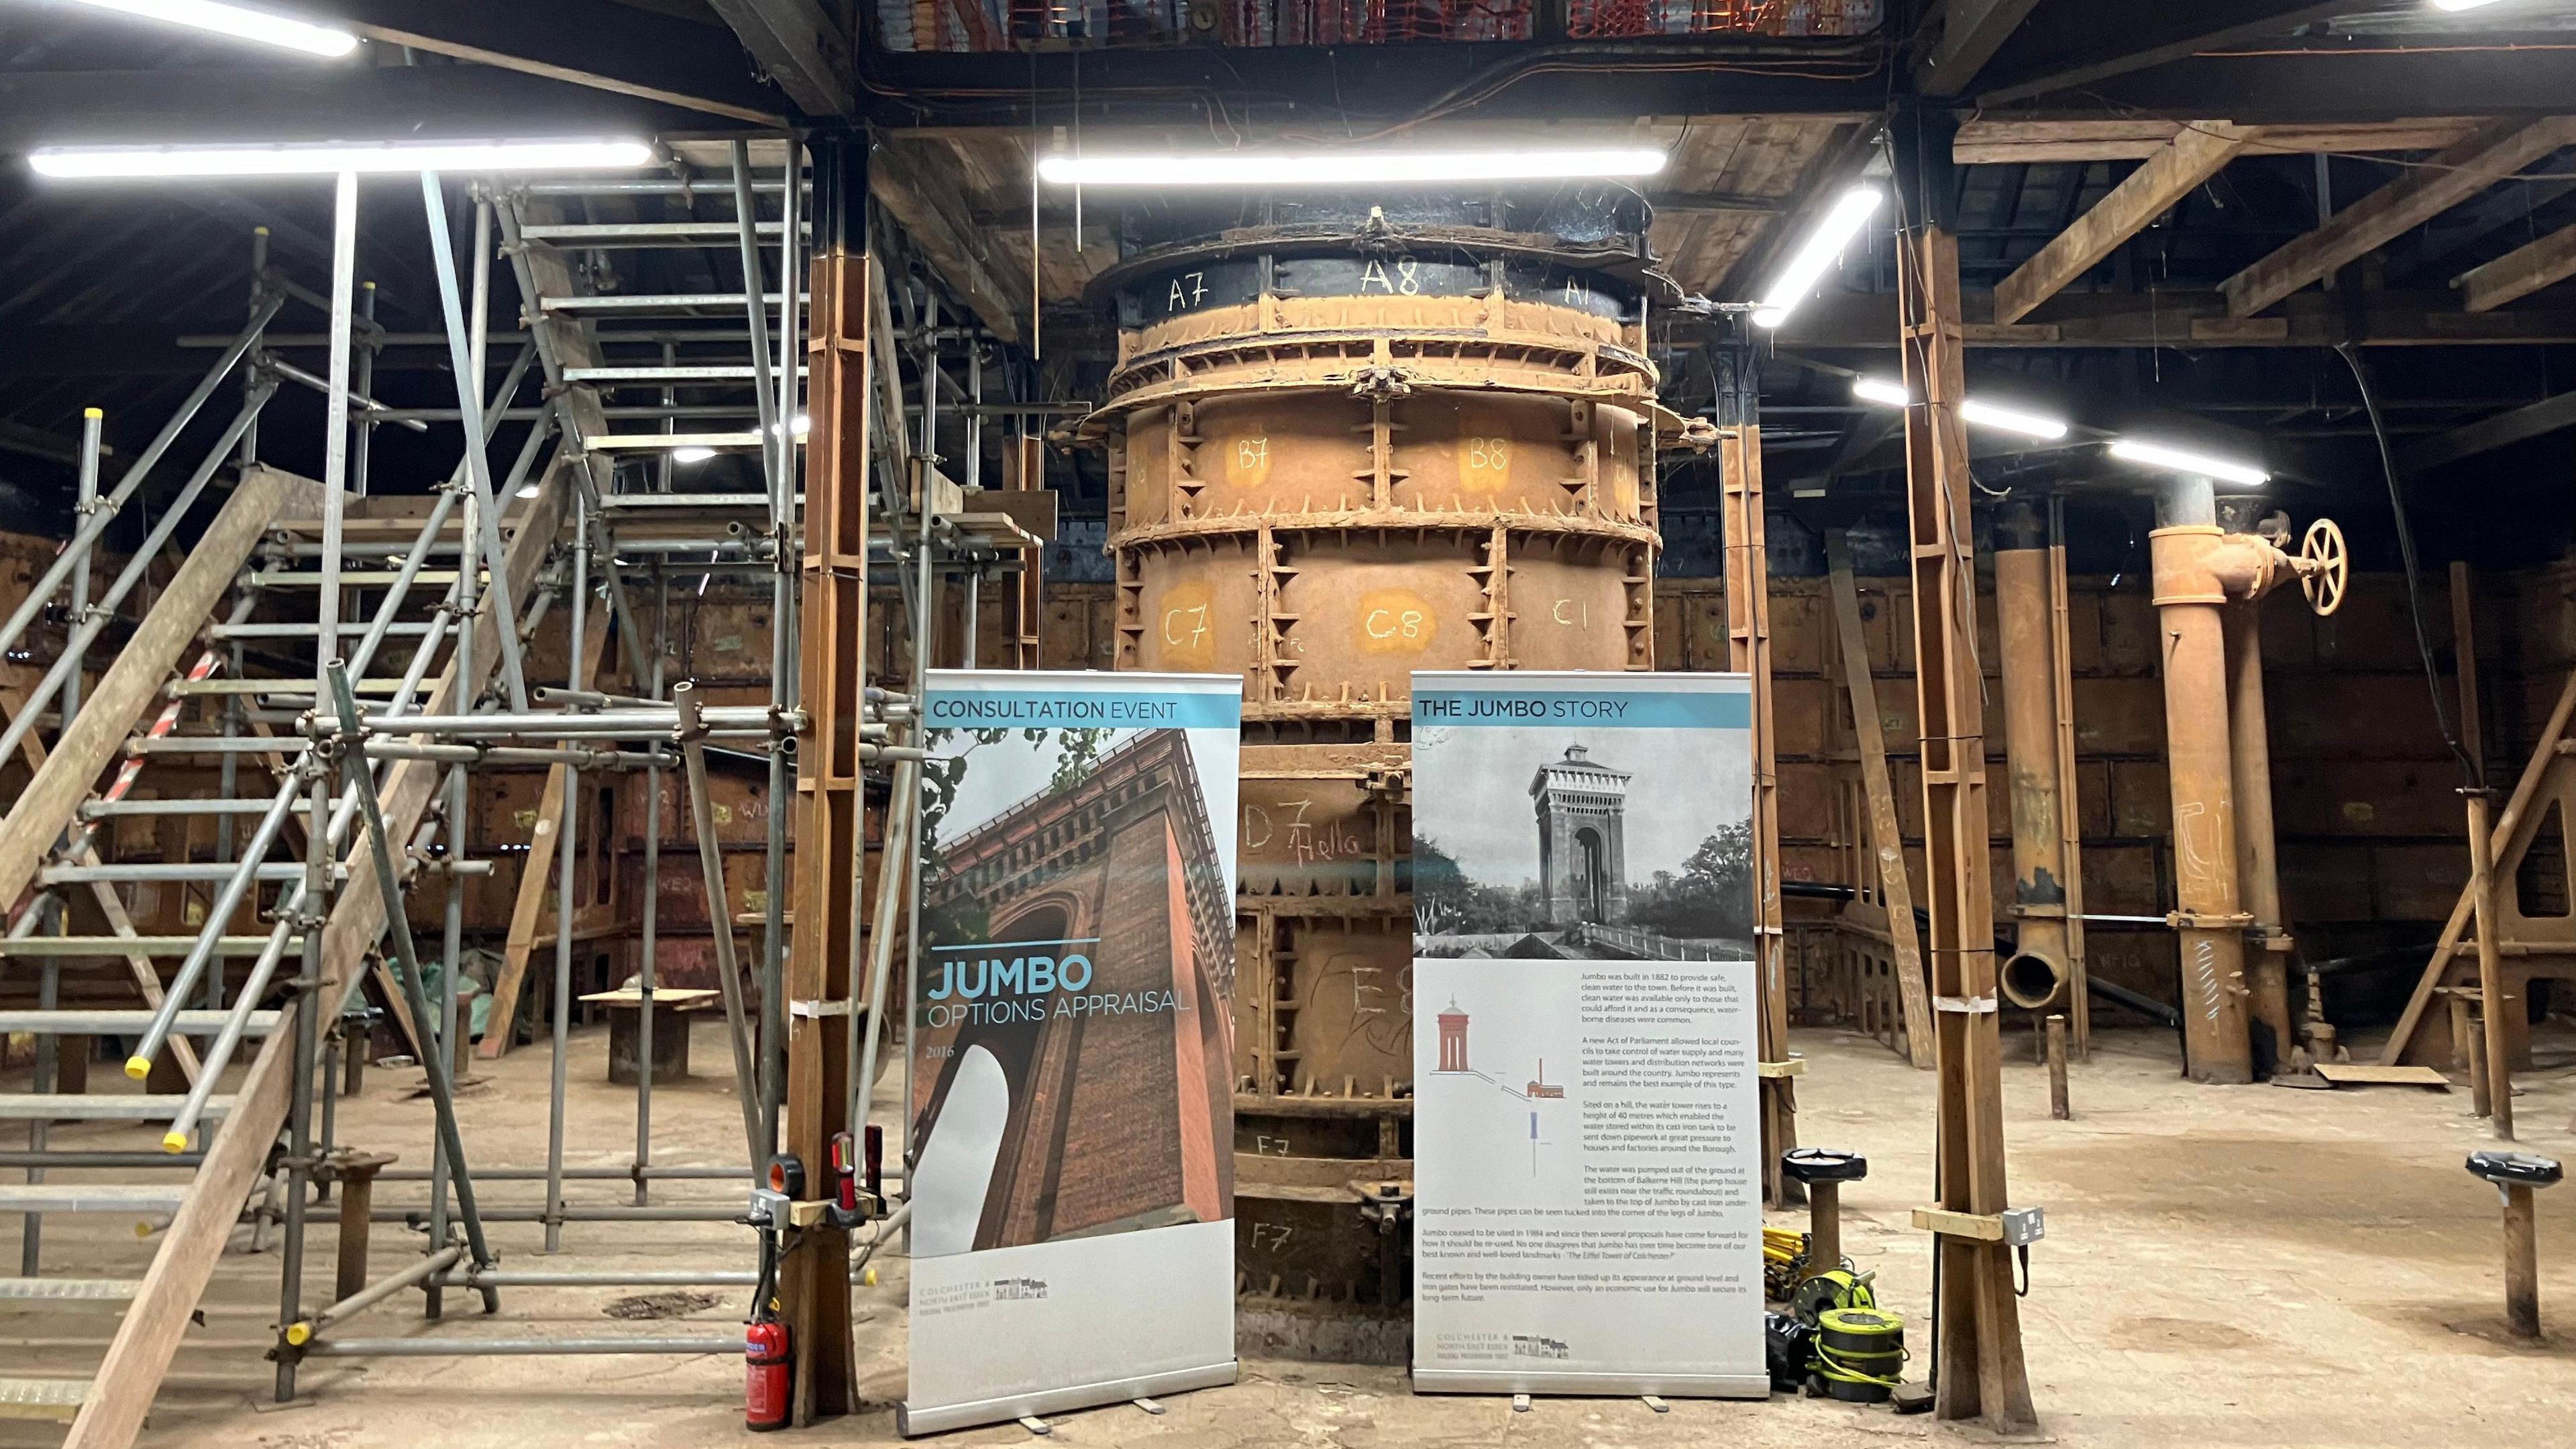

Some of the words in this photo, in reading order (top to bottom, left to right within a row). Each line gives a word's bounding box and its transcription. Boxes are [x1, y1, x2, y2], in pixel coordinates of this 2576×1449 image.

[1361, 256, 1419, 296] A8
[1169, 272, 1208, 311] A7
[1238, 437, 1269, 469] B7
[1470, 437, 1507, 470] B8
[1552, 598, 1587, 631] C1
[1165, 603, 1208, 650] C7
[1366, 610, 1423, 639] C8
[933, 700, 1104, 718] CONSULTATION
[1111, 702, 1178, 719] EVENT
[1419, 700, 1462, 717] THE
[1468, 700, 1546, 718] JUMBO
[1553, 701, 1629, 718] STORY
[928, 954, 1093, 1001] JUMBO
[1581, 971, 1606, 979] Jumbo
[1623, 972, 1640, 980] built
[1642, 972, 1649, 980] in
[1652, 972, 1669, 981] 1882
[1670, 972, 1678, 981] to
[1680, 973, 1709, 982] provide
[1581, 982, 1601, 990] clean
[1602, 982, 1623, 991] water
[1625, 982, 1633, 991] to
[1633, 983, 1646, 991] the
[1670, 983, 1695, 991] Before
[1696, 983, 1701, 991] it
[1581, 993, 1601, 1001] clean
[1602, 993, 1623, 1002] water
[1641, 994, 1673, 1002] available
[1674, 994, 1690, 1004] only
[1693, 994, 1701, 1002] to
[1703, 994, 1723, 1003] those
[1724, 994, 1739, 1003] that
[928, 998, 1046, 1028] OPTIONS
[1053, 989, 1191, 1020] APPRAISAL
[1582, 1004, 1602, 1012] could
[1604, 1004, 1625, 1012] afford
[1627, 1004, 1632, 1012] it
[1633, 1004, 1648, 1012] and
[1582, 1014, 1603, 1022] borne
[1605, 1014, 1635, 1023] diseases
[1582, 1035, 1588, 1043] A
[1607, 1035, 1619, 1044] Act
[1621, 1035, 1628, 1044] of
[1629, 1036, 1669, 1044] Parliament
[1671, 1036, 1700, 1044] allowed
[1702, 1036, 1719, 1045] local
[926, 1046, 955, 1059] 2016
[1582, 1046, 1594, 1055] cils
[1595, 1046, 1603, 1055] to
[1605, 1046, 1620, 1055] take
[1622, 1047, 1648, 1055] control
[1650, 1047, 1658, 1055] of
[1659, 1047, 1680, 1056] water
[1682, 1048, 1707, 1057] supply
[1708, 1048, 1723, 1057] and
[1582, 1057, 1603, 1065] water
[1605, 1057, 1629, 1065] towers
[1631, 1057, 1646, 1065] and
[1647, 1057, 1690, 1066] distribution
[1692, 1058, 1726, 1067] networks
[1582, 1067, 1599, 1075] built
[1601, 1067, 1627, 1076] around
[1629, 1068, 1642, 1076] the
[1675, 1069, 1701, 1077] Jumbo
[1702, 1069, 1740, 1079] represents
[1582, 1078, 1597, 1086] and
[1599, 1078, 1627, 1087] remains
[1629, 1079, 1642, 1087] the
[1643, 1079, 1659, 1087] best
[1660, 1079, 1693, 1089] example
[1694, 1079, 1702, 1087] of
[1704, 1079, 1717, 1088] this
[1583, 1110, 1607, 1120] height
[1609, 1110, 1616, 1119] of
[1618, 1110, 1627, 1119] 40
[1629, 1111, 1654, 1119] metres
[1656, 1111, 1678, 1119] which
[1680, 1111, 1710, 1120] enabled
[1712, 1112, 1724, 1120] the
[1583, 1132, 1599, 1140] sent
[1601, 1132, 1622, 1141] down
[1623, 1133, 1658, 1142] pipework
[1660, 1133, 1667, 1141] at
[1669, 1133, 1688, 1143] great
[1723, 1134, 1731, 1142] to
[1257, 1136, 1289, 1157] F7
[1585, 1165, 1597, 1173] The
[1599, 1165, 1619, 1173] water
[1638, 1165, 1670, 1175] pumped
[1671, 1165, 1684, 1173] out
[1685, 1165, 1693, 1174] of
[1695, 1165, 1707, 1174] the
[1709, 1166, 1736, 1175] ground
[1737, 1166, 1745, 1174] at
[1422, 1206, 1449, 1216] ground
[1474, 1206, 1495, 1215] These
[1497, 1207, 1517, 1216] pipes
[1534, 1207, 1544, 1216] be
[1564, 1208, 1590, 1216] tucked
[1591, 1208, 1606, 1216] into
[1607, 1208, 1620, 1216] the
[1648, 1208, 1655, 1216] of
[1656, 1208, 1669, 1216] the
[1687, 1208, 1695, 1217] of
[1251, 1222, 1293, 1253] F7
